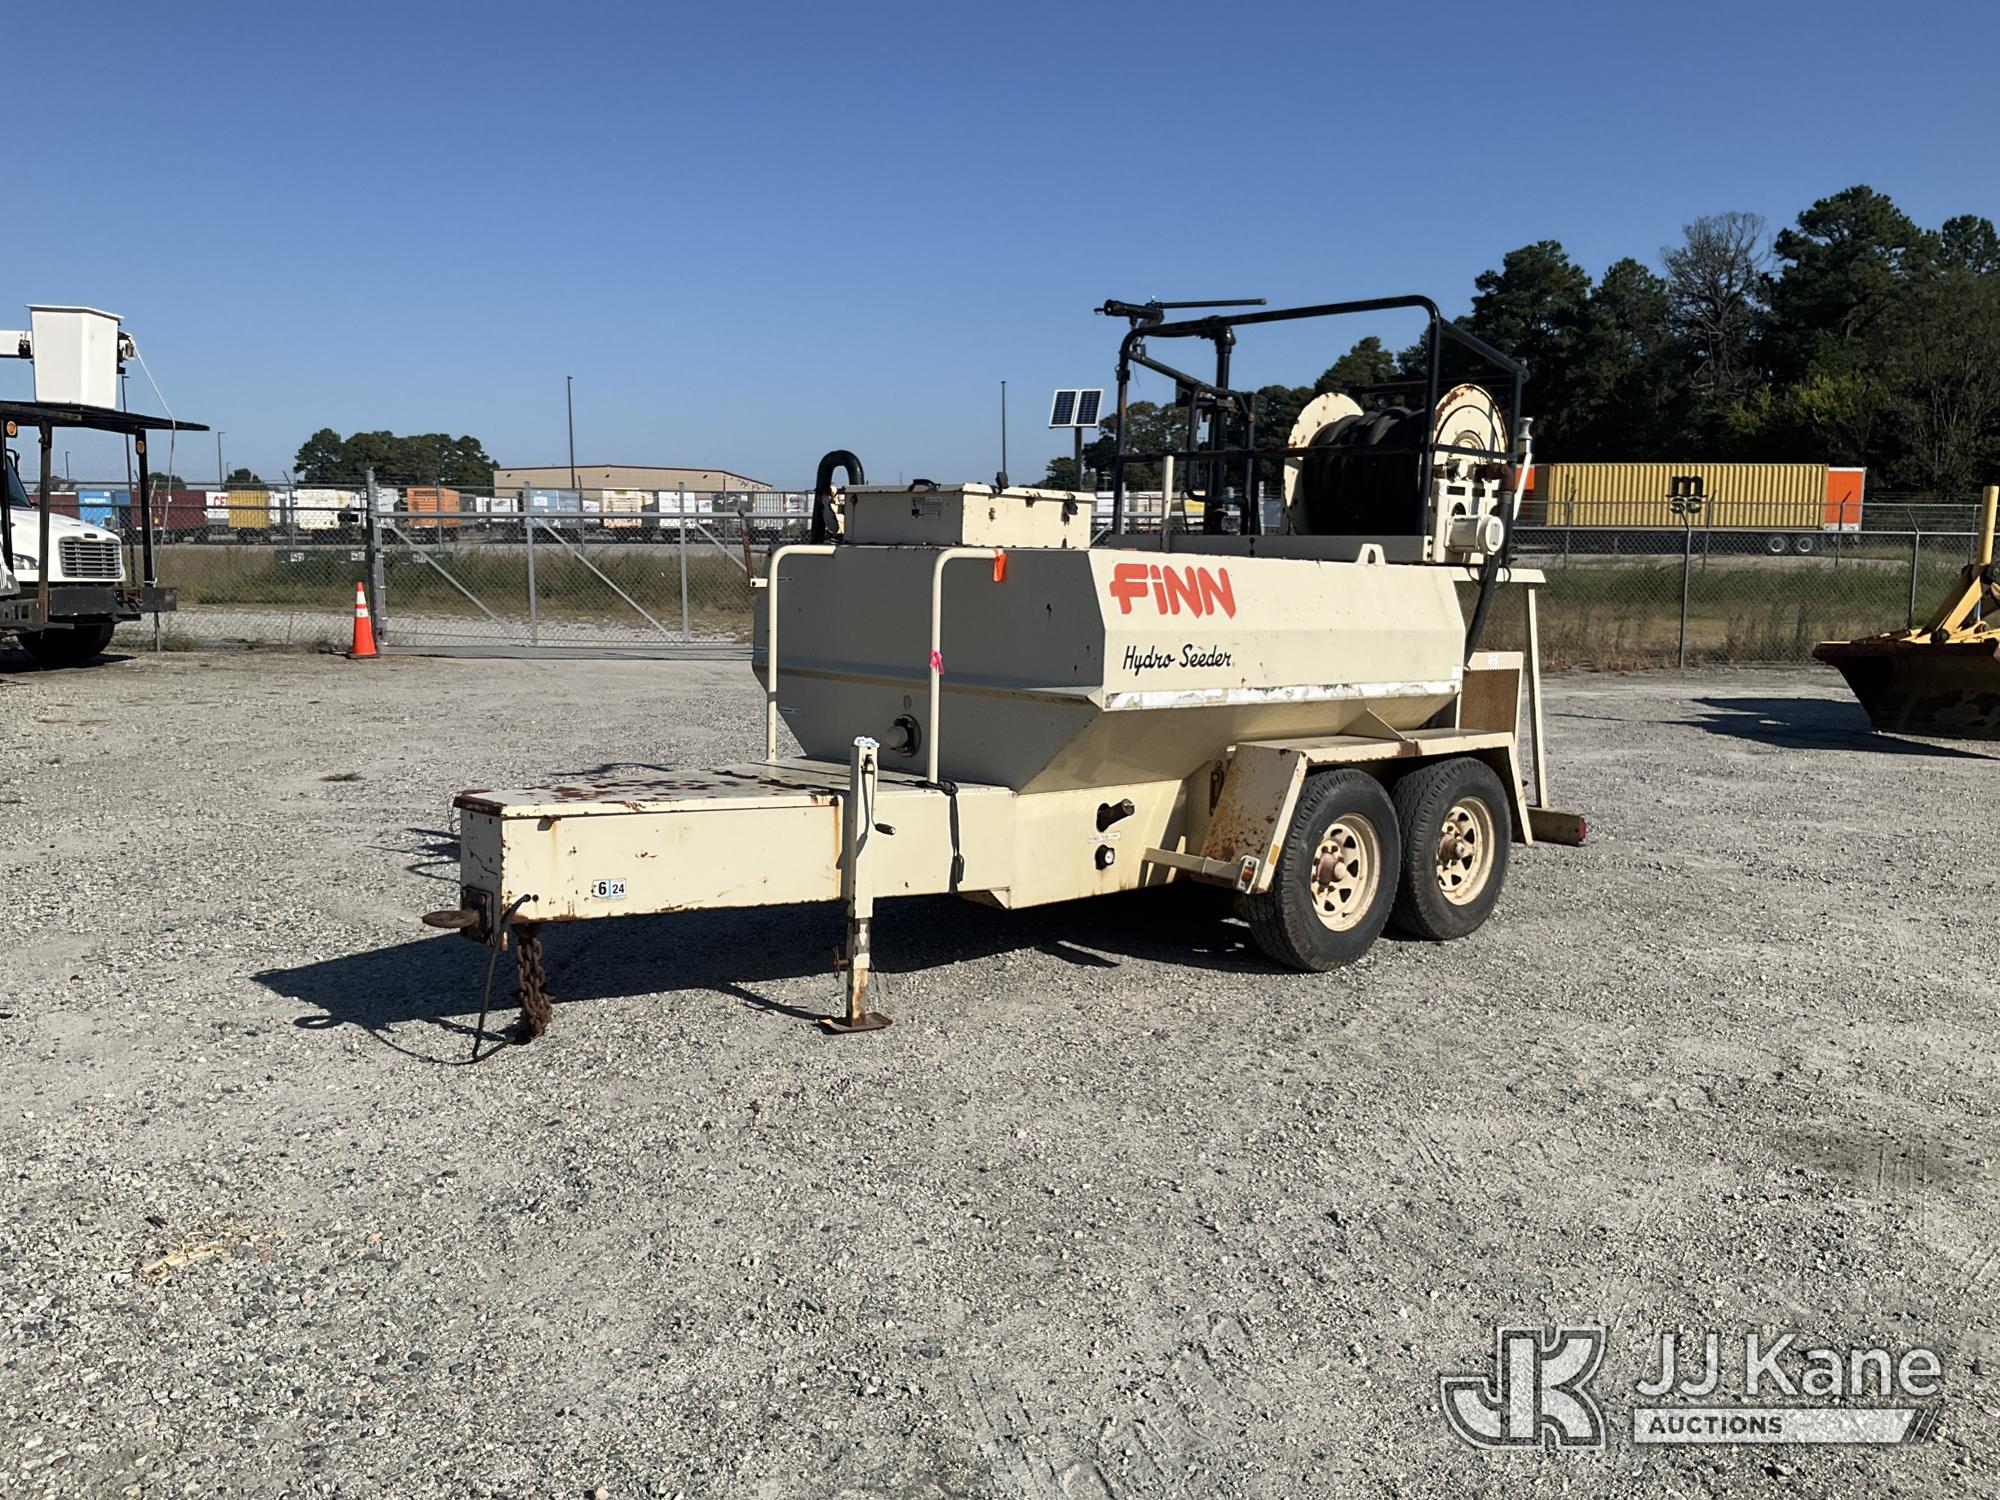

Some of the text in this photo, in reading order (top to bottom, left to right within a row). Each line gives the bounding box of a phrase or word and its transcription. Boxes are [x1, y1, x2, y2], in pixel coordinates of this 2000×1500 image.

[1122, 643, 1231, 676] Hydro Seeder
[598, 881, 625, 896] 6 24
